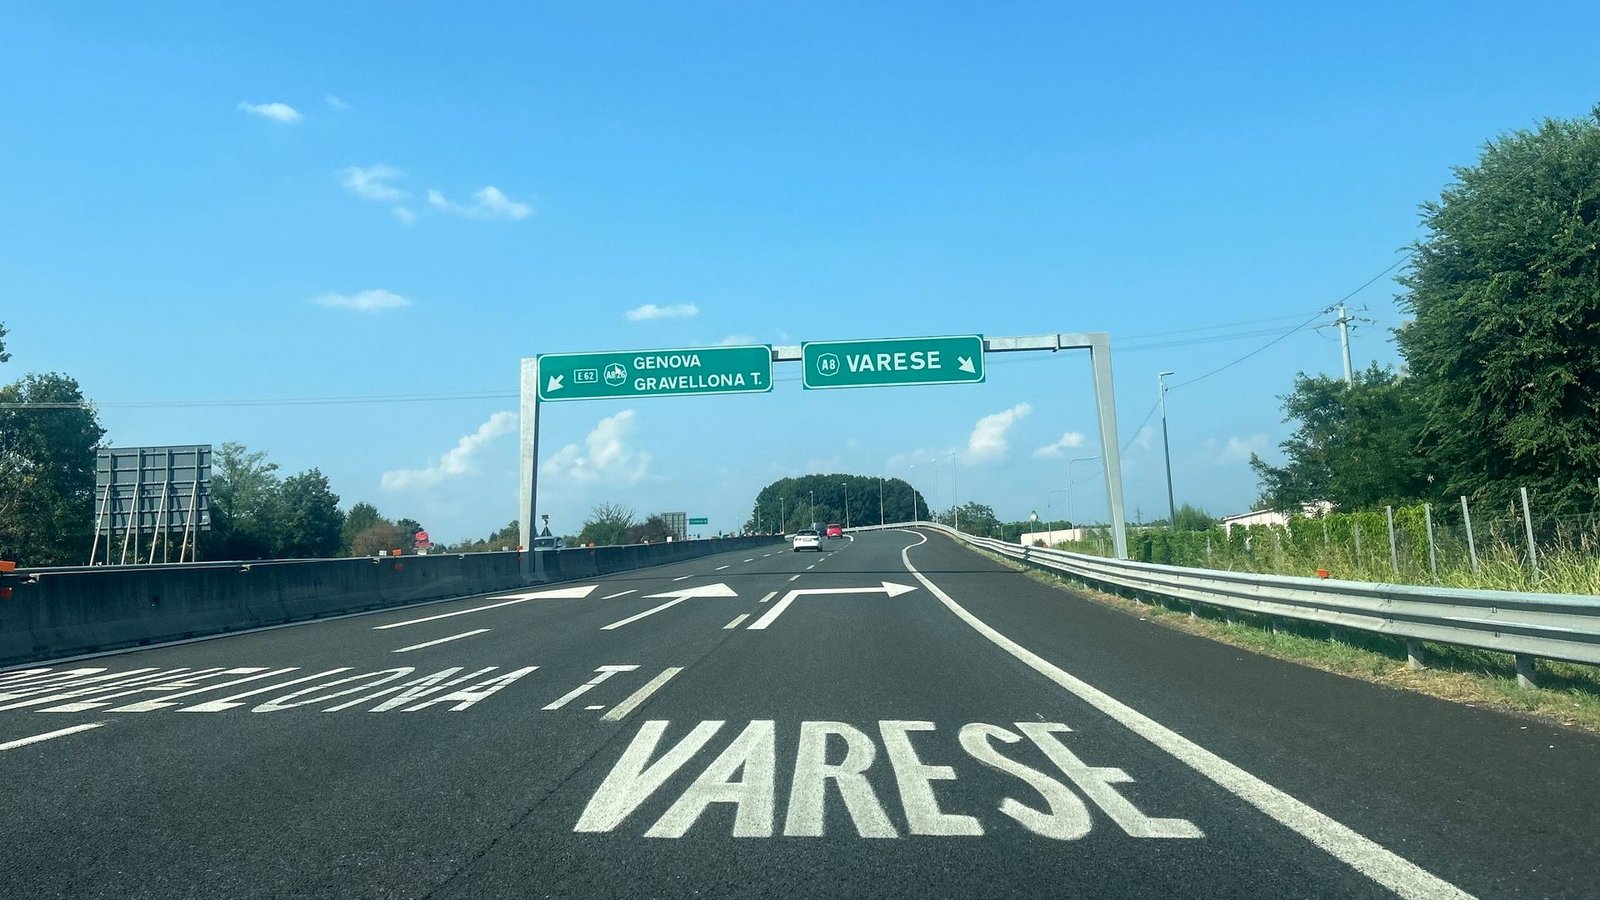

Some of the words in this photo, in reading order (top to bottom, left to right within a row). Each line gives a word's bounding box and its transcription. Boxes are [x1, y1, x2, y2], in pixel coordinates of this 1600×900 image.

[633, 354, 701, 370] GENOVA
[821, 359, 835, 370] A8
[846, 351, 941, 372] VARESE
[578, 372, 582, 381] E
[584, 371, 594, 380] 62
[634, 373, 746, 391] GRAVELLONA
[751, 371, 762, 386] T.
[541, 664, 641, 711] T.
[573, 719, 1205, 839] VARESE
